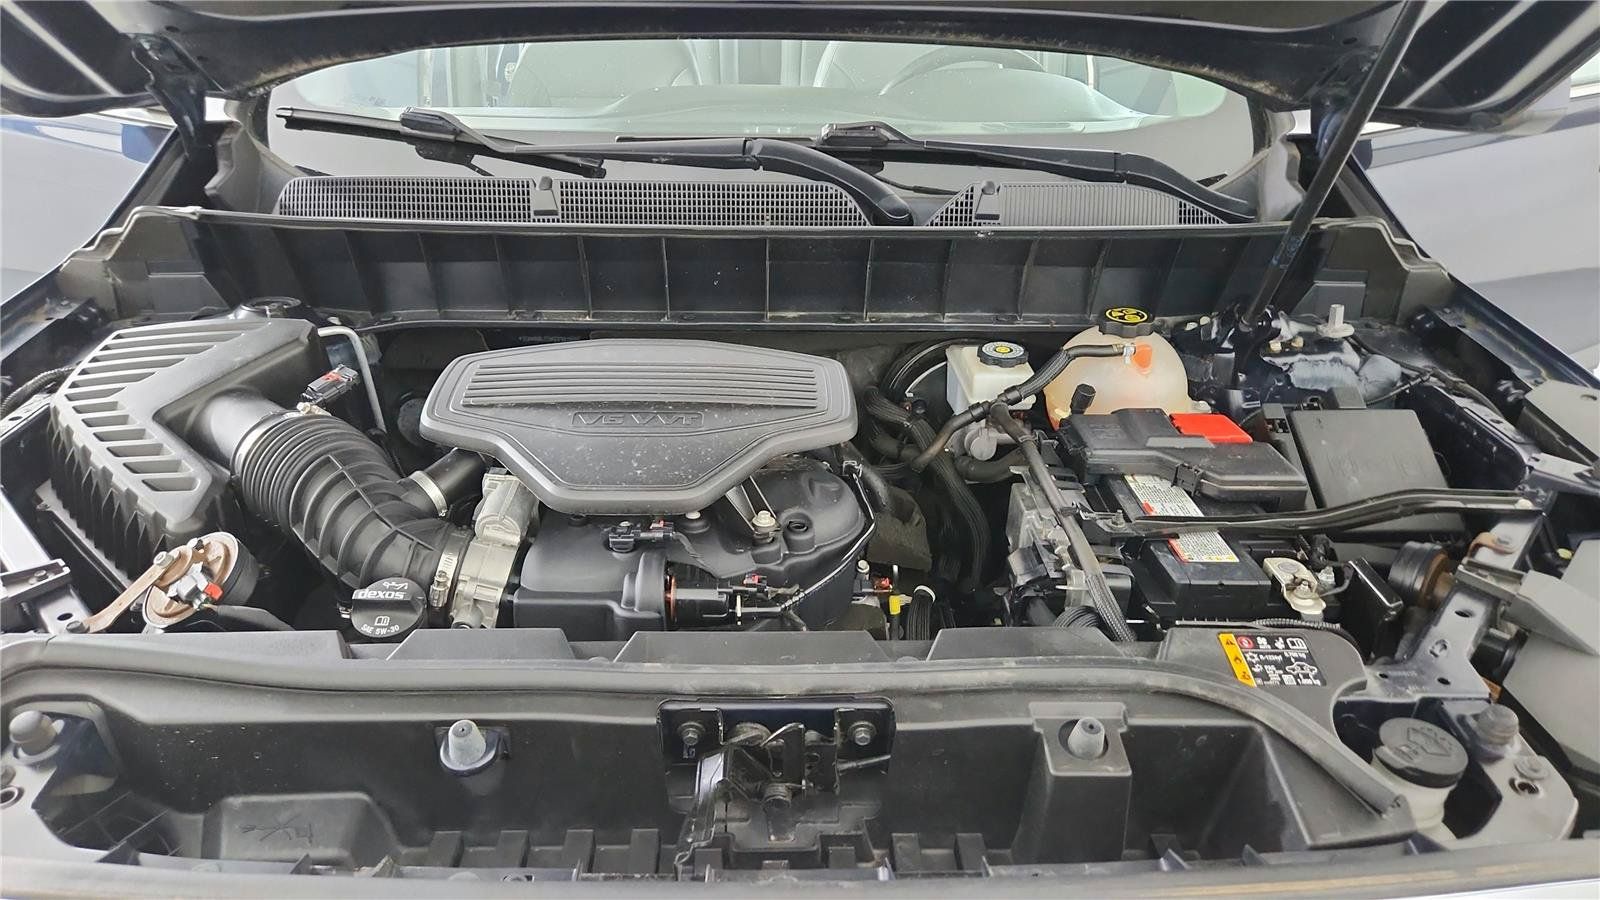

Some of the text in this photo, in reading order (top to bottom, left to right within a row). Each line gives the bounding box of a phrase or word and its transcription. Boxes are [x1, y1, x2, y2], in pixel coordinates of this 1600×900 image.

[578, 414, 624, 425] V6
[358, 590, 405, 599] dexos
[361, 624, 400, 635] SAE 5W-30
